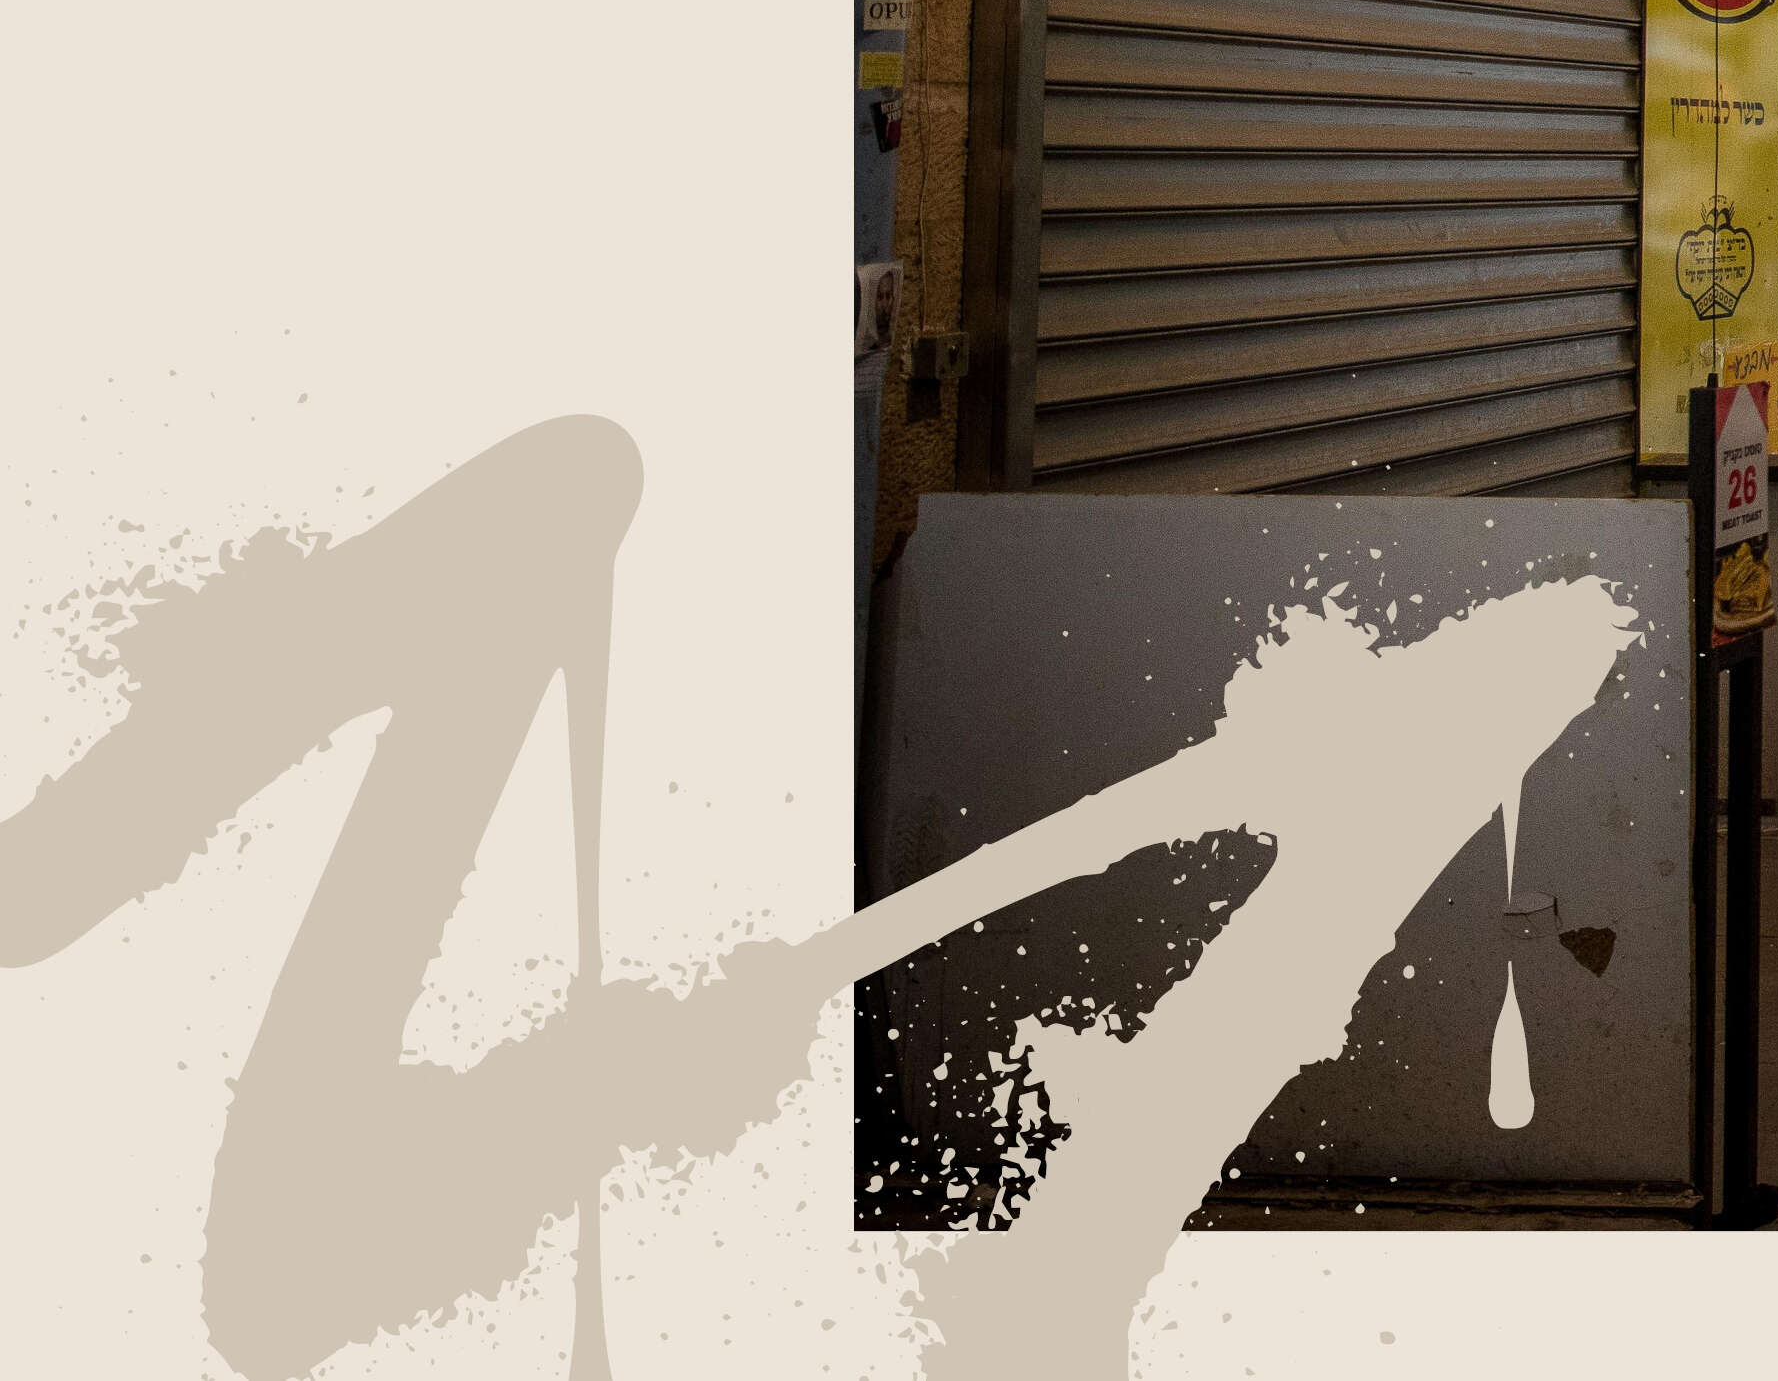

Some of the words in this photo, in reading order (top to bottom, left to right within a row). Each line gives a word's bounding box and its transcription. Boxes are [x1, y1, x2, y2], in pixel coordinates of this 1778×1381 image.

[1670, 84, 1731, 138] למהדרין
[1732, 100, 1765, 126] כשר
[1728, 464, 1758, 511] 26
[1722, 515, 1741, 531] MEAT
[1740, 510, 1763, 525] TOAST
